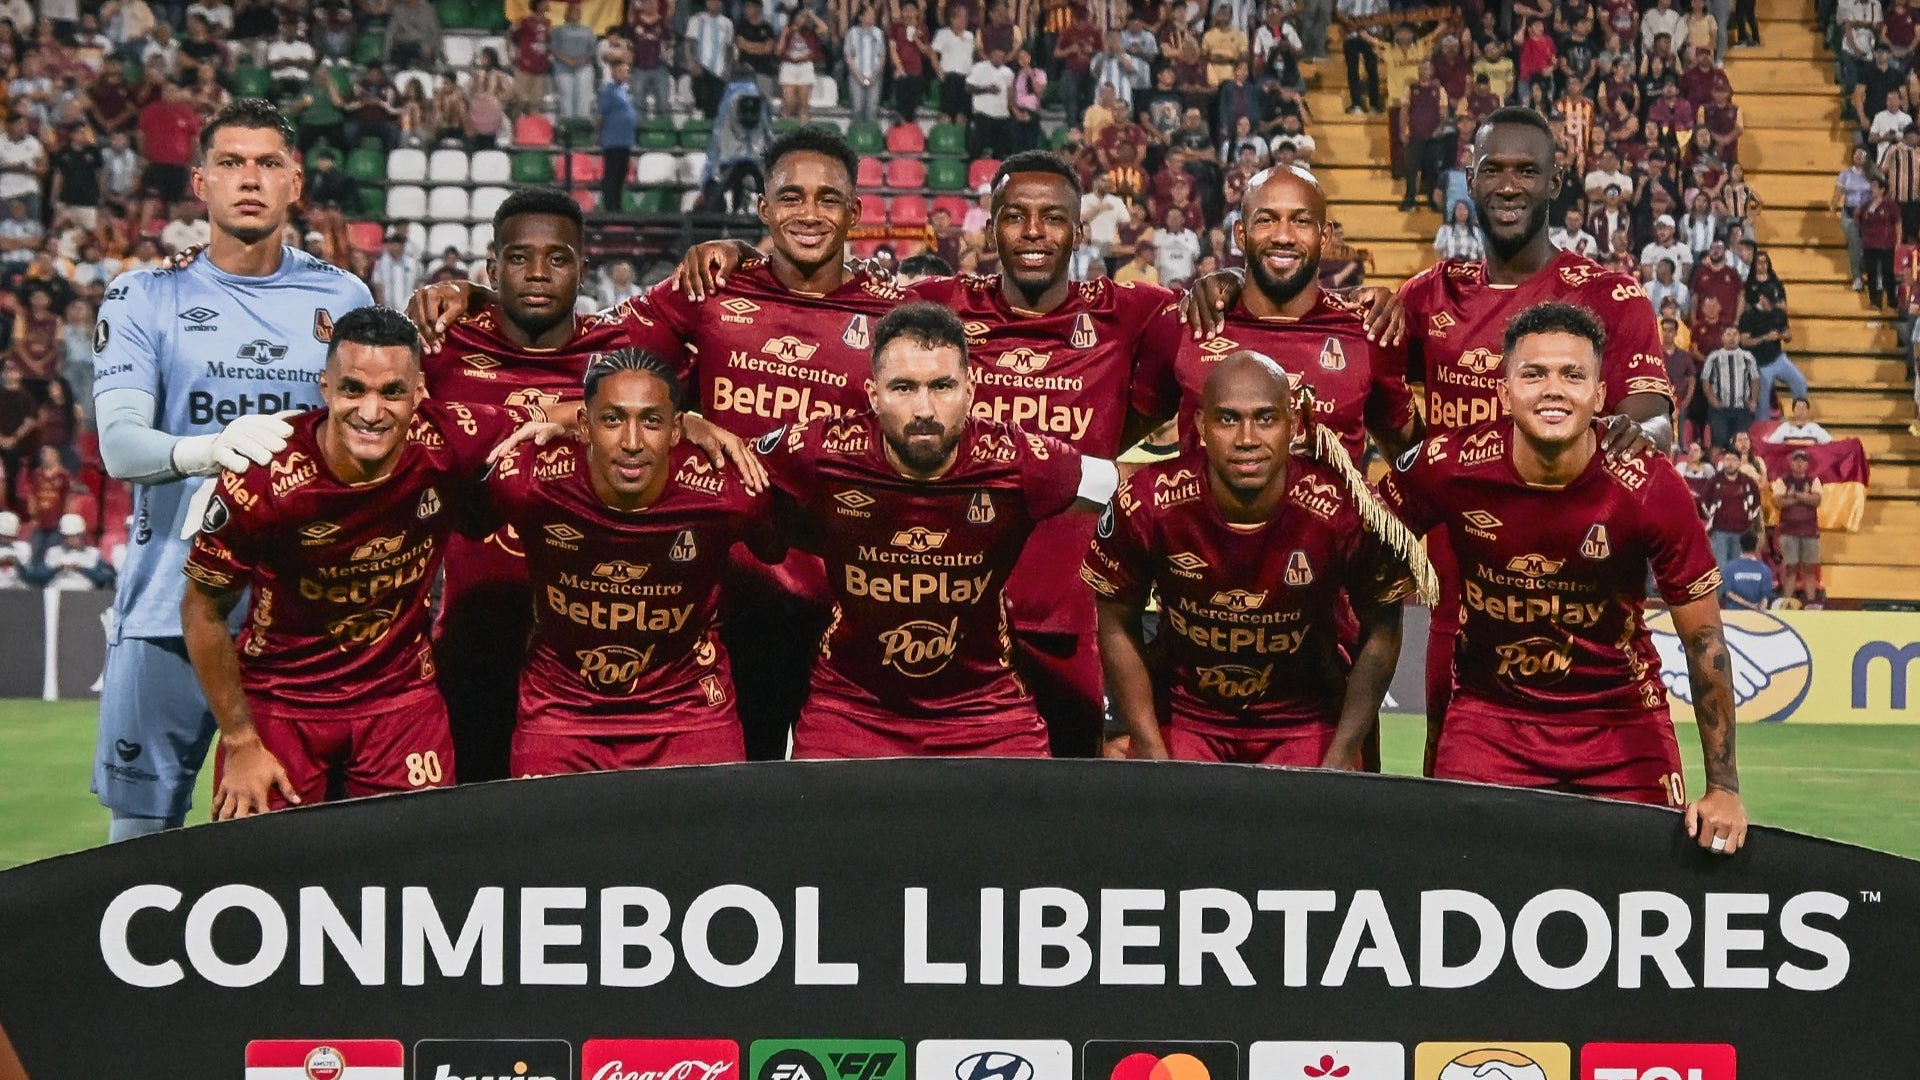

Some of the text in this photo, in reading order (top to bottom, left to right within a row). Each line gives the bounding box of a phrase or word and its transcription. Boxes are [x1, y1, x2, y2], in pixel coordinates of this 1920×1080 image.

[184, 323, 218, 332] umbro
[721, 314, 754, 324] umbro
[965, 336, 987, 345] mbro
[728, 350, 848, 389] Mercacentro
[1200, 353, 1228, 362] umbr
[463, 368, 497, 380] umbro
[968, 366, 1084, 392] Mercacentro
[1437, 364, 1499, 390] Mercace
[972, 395, 1095, 441] etPlay
[1430, 391, 1512, 429] BetPl
[1458, 440, 1505, 463] Multi
[271, 460, 319, 496] Multi
[532, 457, 576, 478] Multi
[674, 469, 725, 493] Multi
[1153, 479, 1201, 507] Multi
[1289, 484, 1340, 517] Multi
[836, 507, 871, 519] umbro
[545, 537, 579, 551] umbro
[1464, 525, 1498, 542] umbro
[318, 537, 433, 578] Mercacentro
[858, 545, 984, 567] Mercacentro
[559, 570, 683, 597] Mercacentro
[844, 563, 993, 605] BetPlay
[1169, 565, 1203, 580] umbro
[1476, 563, 1597, 592] Mercacentro
[546, 584, 695, 634] BetPlay
[1178, 596, 1302, 625] Mercacentro
[1465, 579, 1607, 629] BetPlay
[877, 615, 960, 667] Pool
[1167, 604, 1312, 655] BetPlay
[575, 642, 657, 686] Pool
[1495, 634, 1576, 678] Pool
[1194, 662, 1275, 698] Pool
[405, 749, 443, 787] 80
[1658, 771, 1686, 807] 10
[98, 883, 861, 989] CONMEBOL
[902, 884, 1852, 991] LIBERTADORES
